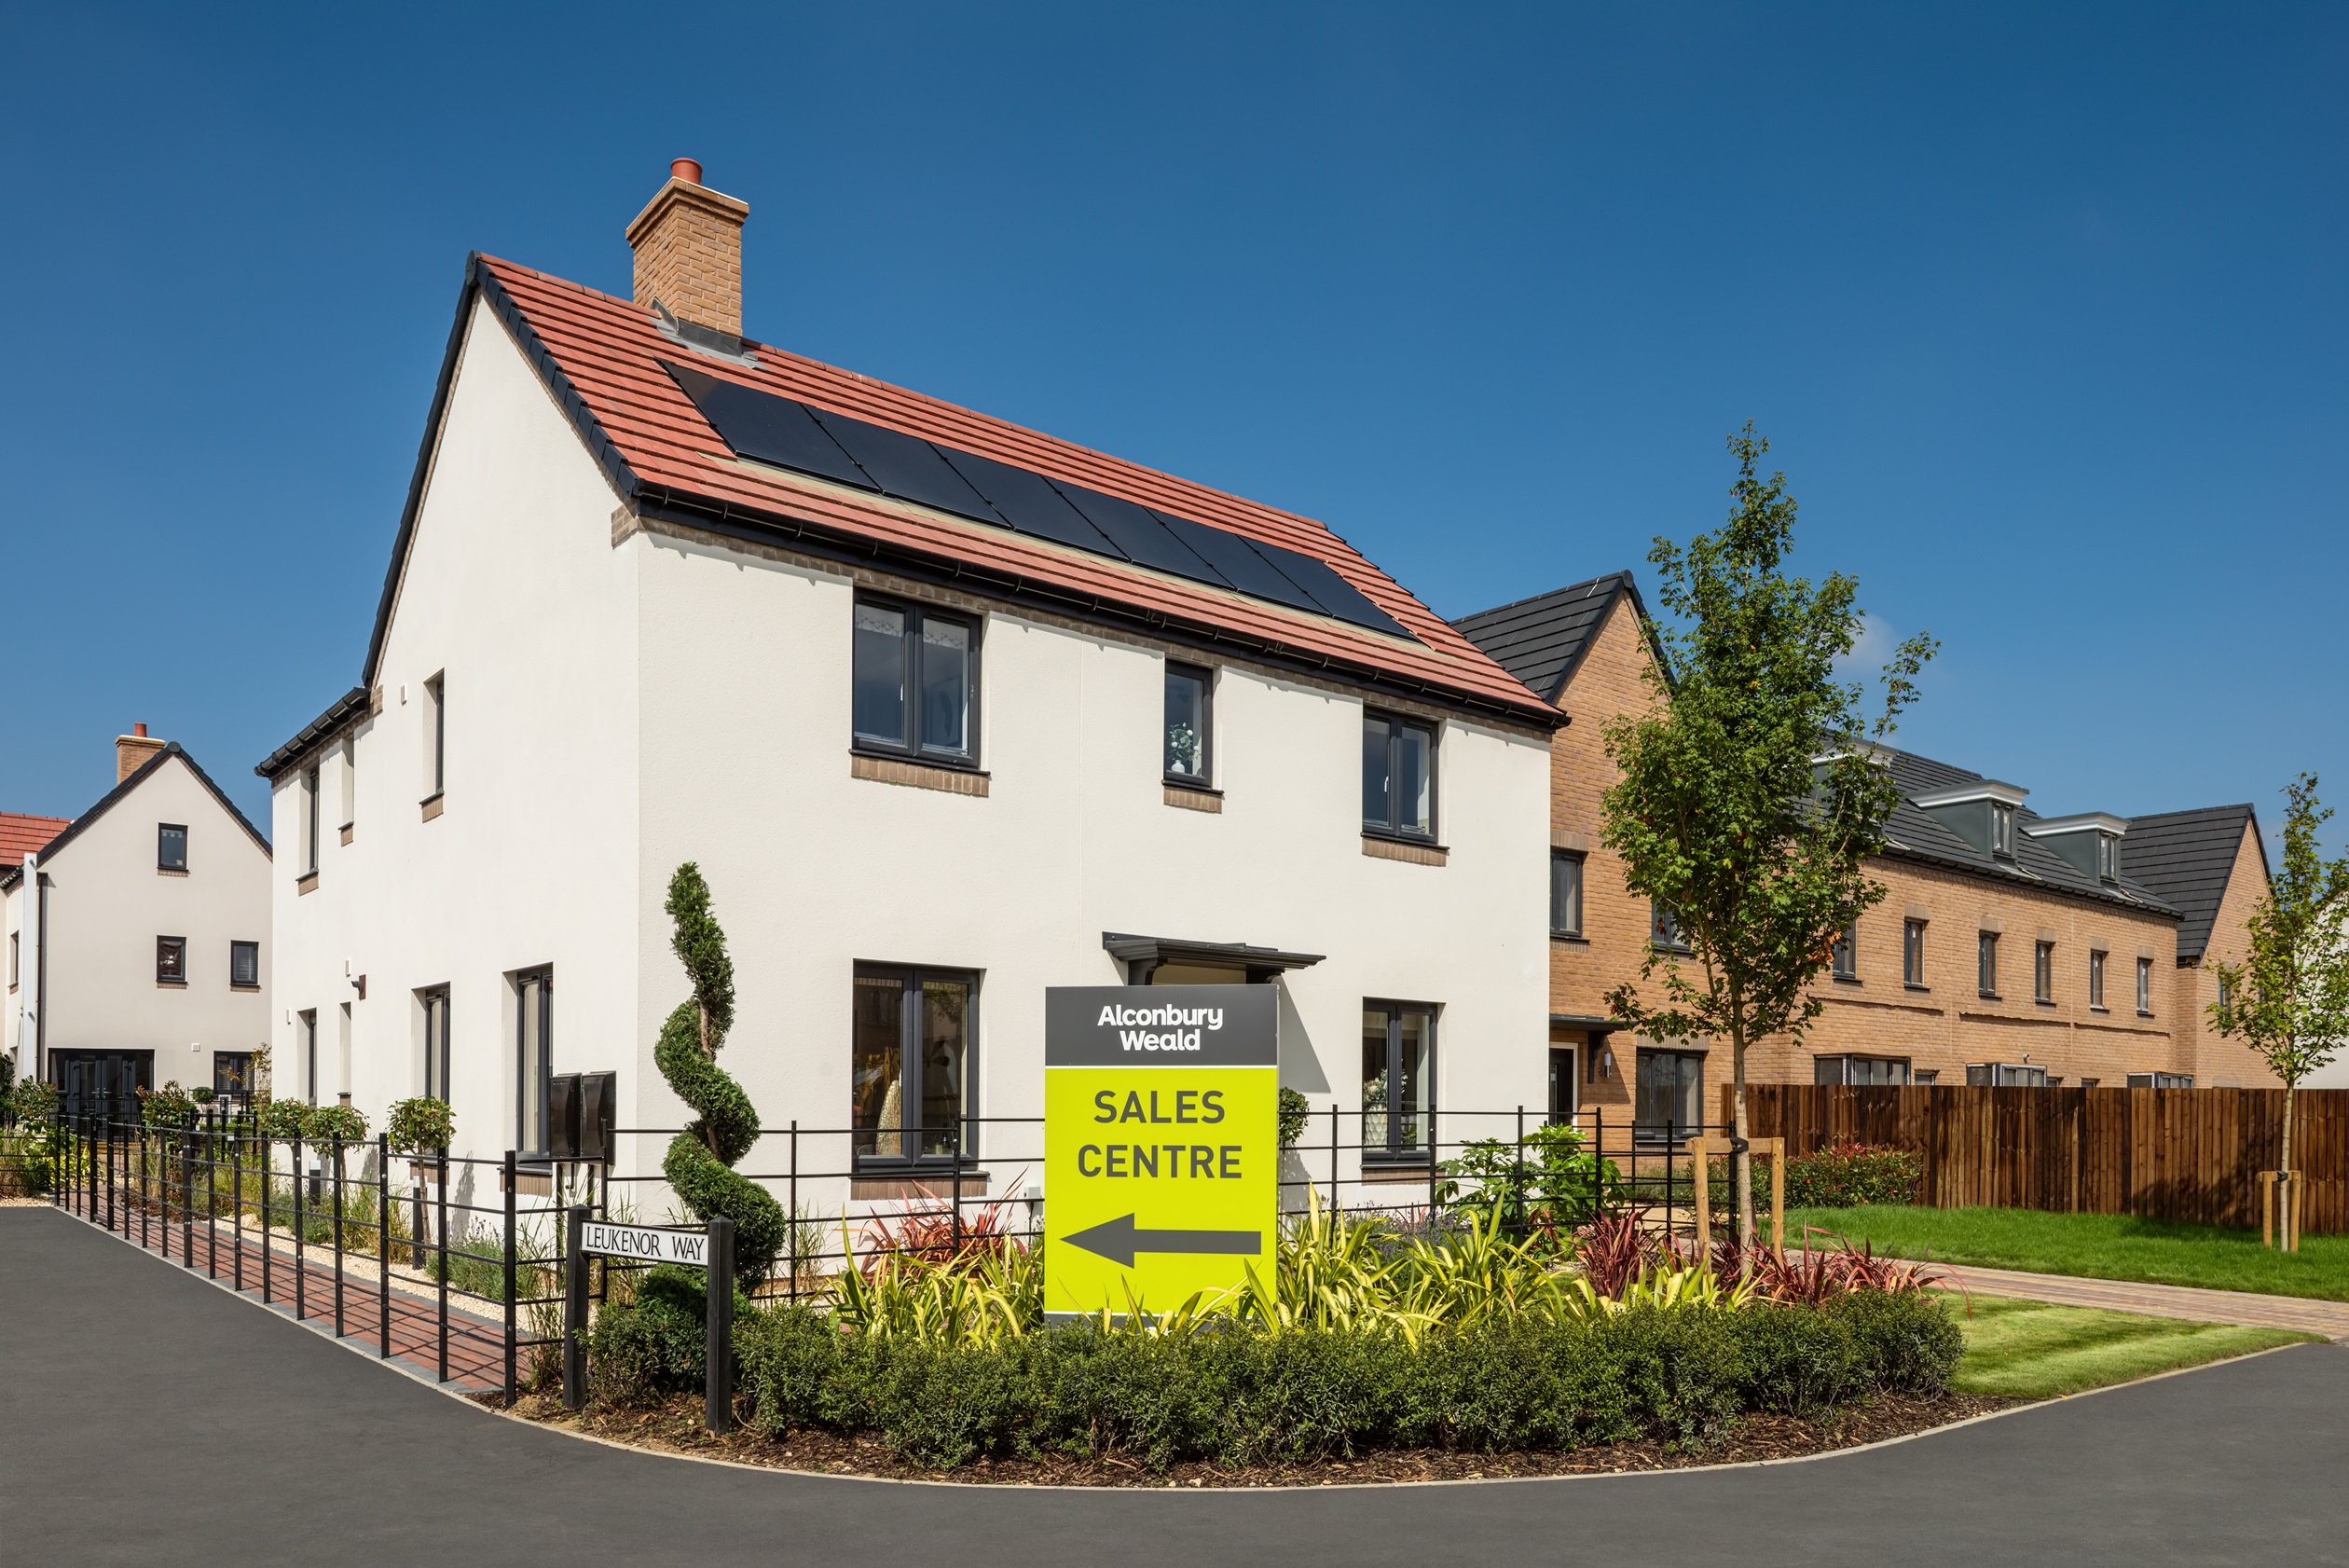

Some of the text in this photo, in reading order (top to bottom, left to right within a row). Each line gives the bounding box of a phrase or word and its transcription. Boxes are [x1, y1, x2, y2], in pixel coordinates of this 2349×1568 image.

[1097, 1004, 1223, 1030] Alconbury
[1120, 1029, 1201, 1051] Weald
[1093, 1090, 1225, 1124] SALES
[1078, 1144, 1243, 1178] CENTRE
[586, 1226, 705, 1260] LEUKENOR WAY
